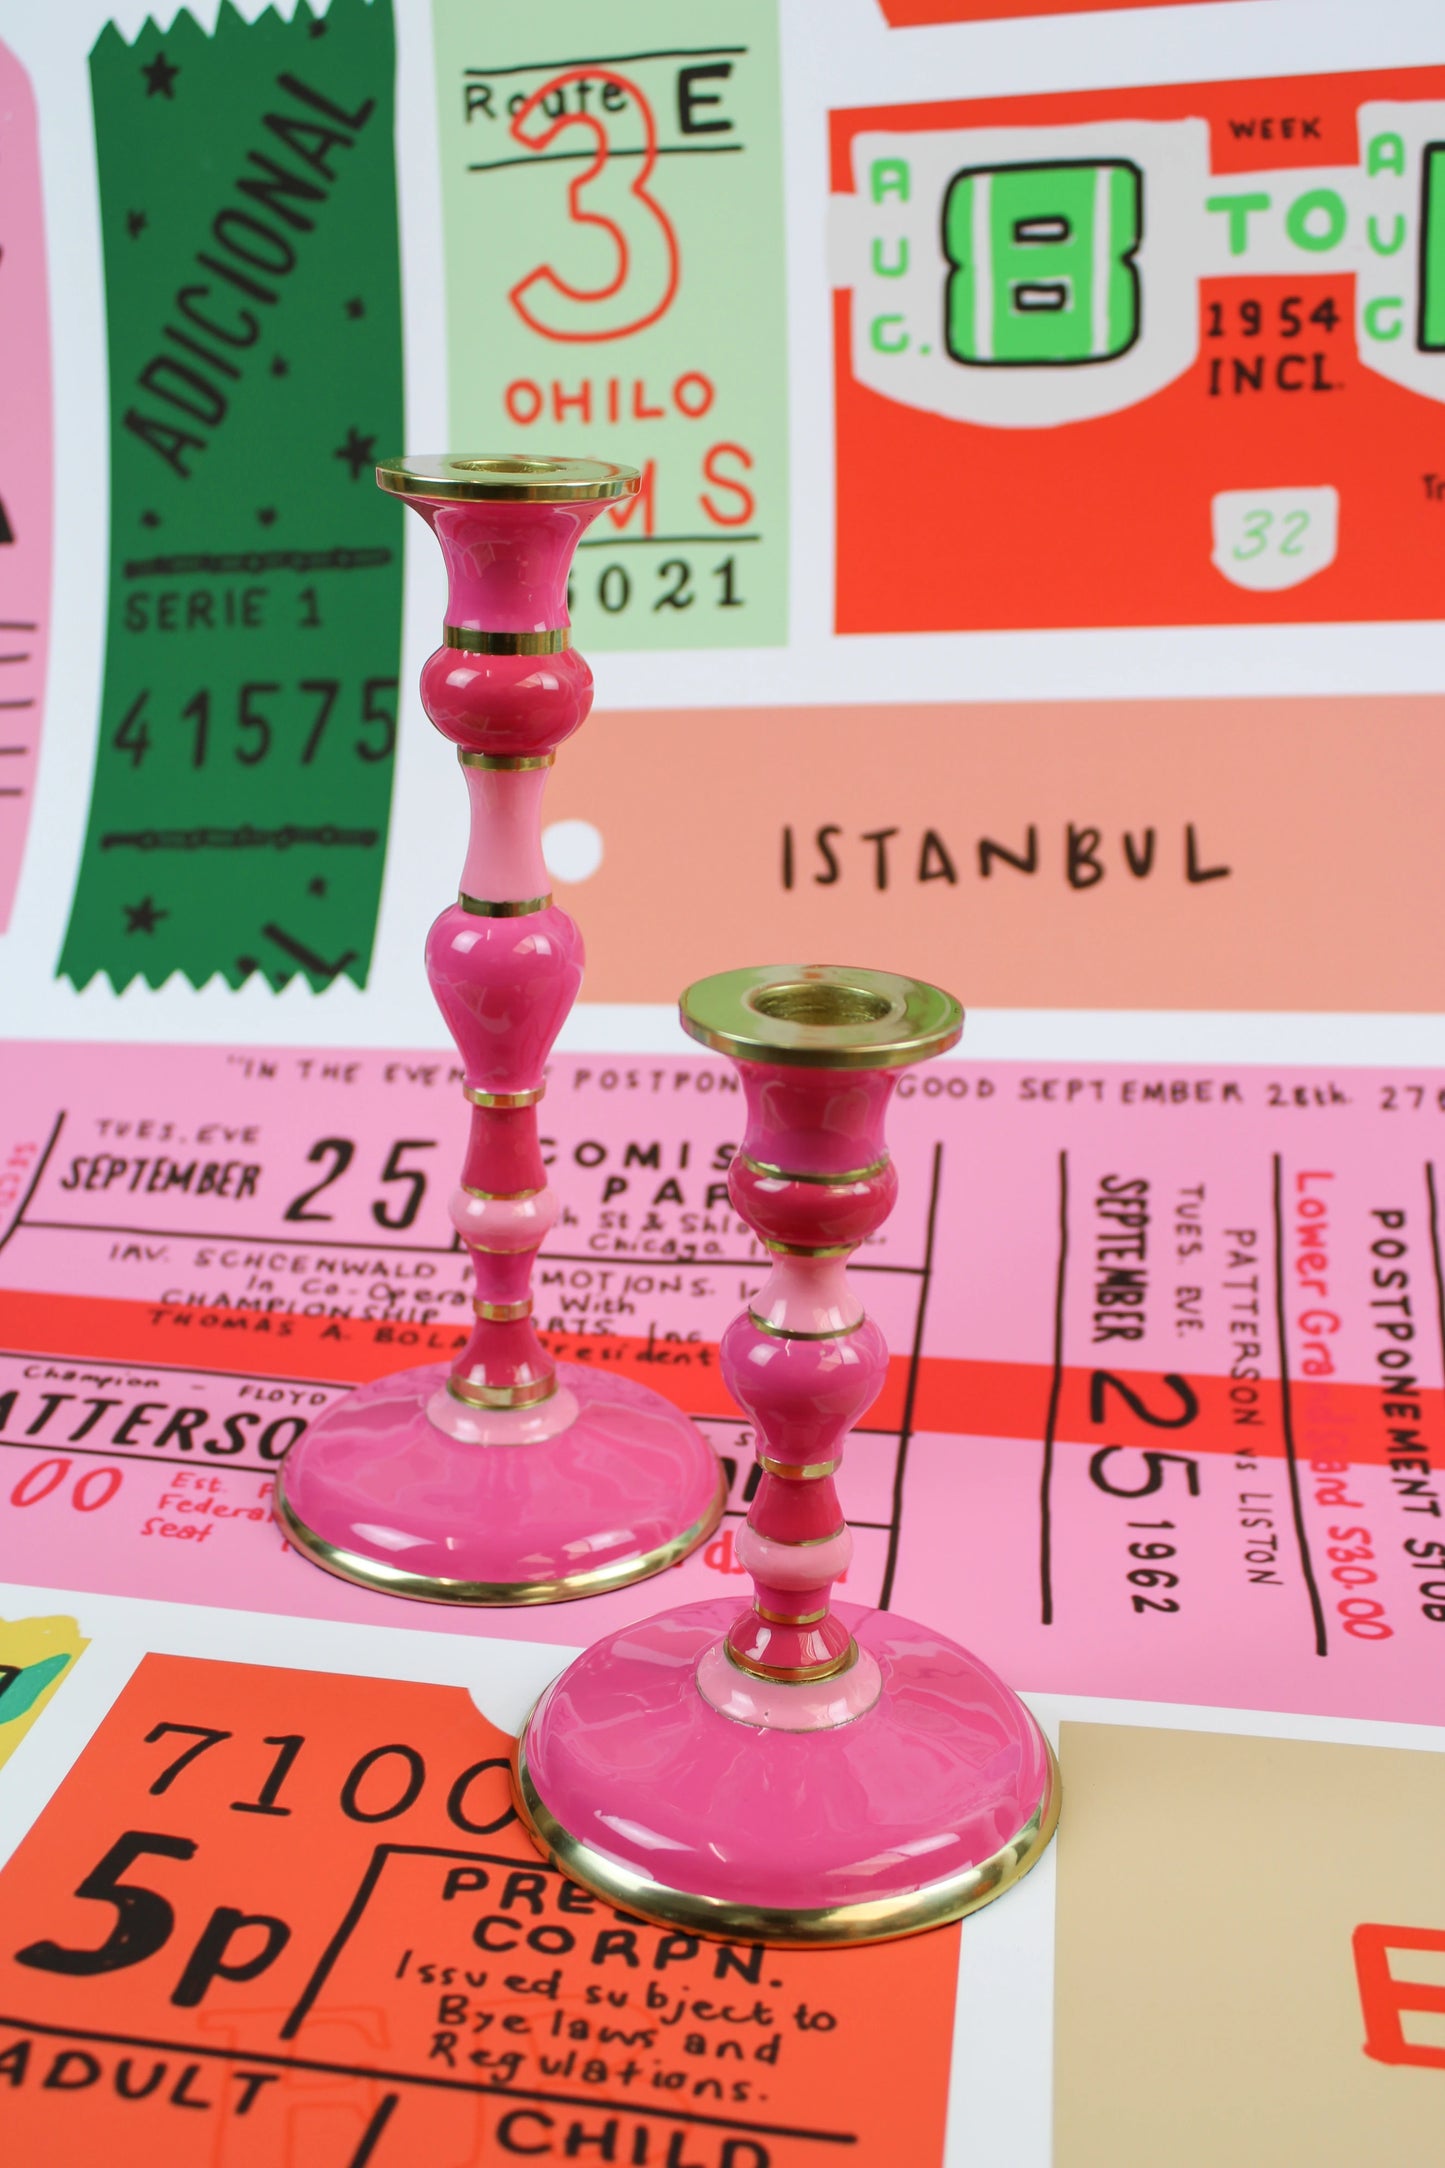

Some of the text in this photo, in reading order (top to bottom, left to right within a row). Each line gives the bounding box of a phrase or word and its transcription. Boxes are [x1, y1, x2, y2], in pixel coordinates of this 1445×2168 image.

[463, 62, 733, 135] Route E
[1228, 117, 1322, 140] WEEK
[507, 66, 681, 343] 3
[1205, 188, 1347, 256] TO
[123, 72, 376, 479] ADICIONAL
[940, 157, 1143, 368] 8
[1208, 297, 1341, 338] 1954
[504, 370, 716, 426] OHILO
[1232, 508, 1311, 561] 32
[124, 586, 323, 633] SERIE 1
[568, 554, 746, 615] 021
[113, 677, 399, 769] 41575
[781, 821, 1232, 892] ISTANBUL
[301, 1059, 360, 1084] THE
[898, 1073, 995, 1102] GOOD
[1019, 1076, 1242, 1104] SEPTEMBER
[60, 1153, 262, 1200] SEPTEMBER
[283, 1136, 437, 1230] 25
[1295, 1171, 1335, 1298] Lower
[149, 1309, 293, 1337] THOMAS
[160, 1289, 440, 1326] CHAMPIONSHIP
[246, 1274, 274, 1293] In
[560, 1294, 635, 1316] With
[1223, 1229, 1264, 1427] PATTERSON
[23, 1365, 327, 1406] Champion FLOYD
[1089, 1174, 1201, 1614] SEPTEMBER 25 1962
[1369, 1208, 1442, 1518] POSTPONEMENT
[140, 1517, 214, 1543] Seat
[1238, 1493, 1284, 1586] LISTON
[144, 1721, 518, 1835] 7100
[14, 1830, 291, 2007] 5p
[442, 1866, 647, 1926] PRE
[473, 1915, 782, 1987] CORPN.
[395, 1950, 837, 2033] Issued subject to
[437, 1994, 782, 2065] Bye laws and
[0, 2038, 280, 2117] ADULT
[428, 2031, 768, 2104] Regulations.
[496, 2108, 771, 2168] CHILD
